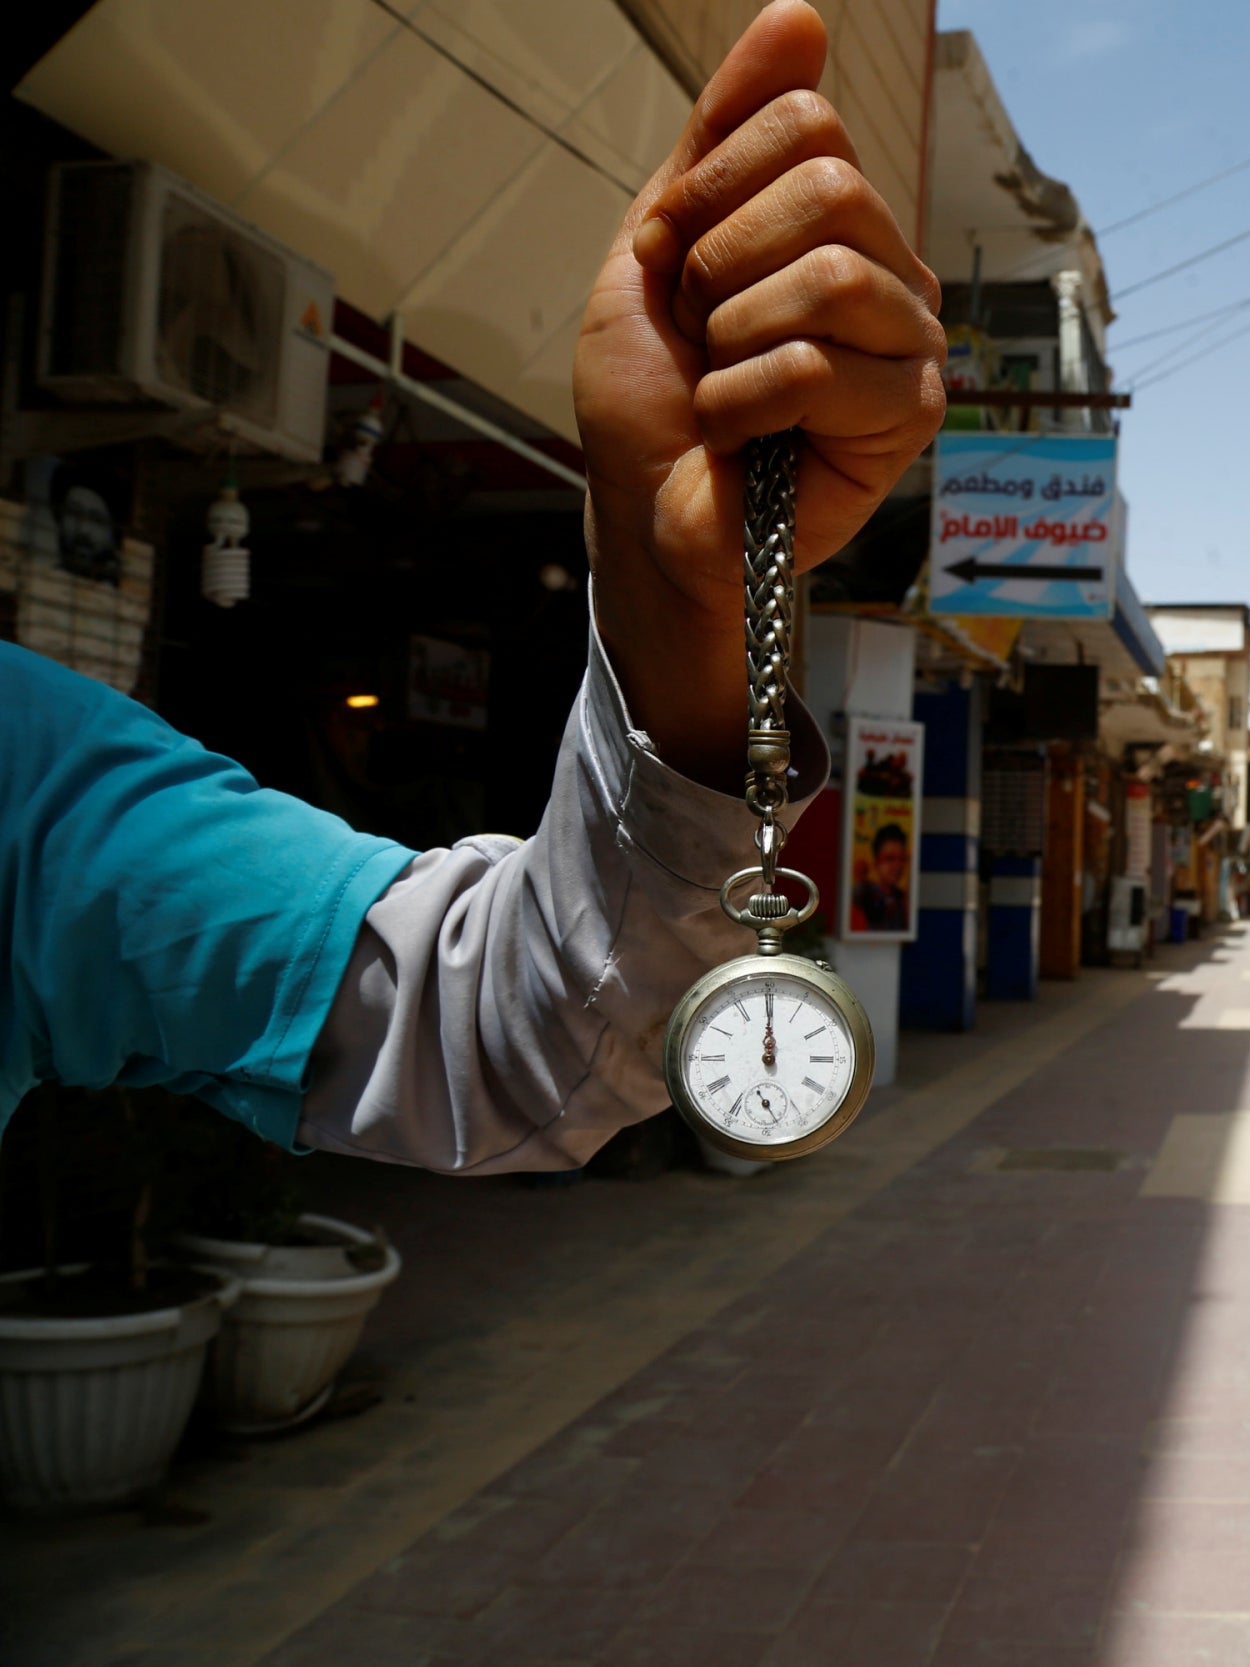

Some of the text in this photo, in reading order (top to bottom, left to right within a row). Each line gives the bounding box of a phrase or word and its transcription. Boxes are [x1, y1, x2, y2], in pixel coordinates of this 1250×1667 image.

[940, 471, 1106, 501] فندق ومطعم
[1024, 514, 1108, 546] ضيوف
